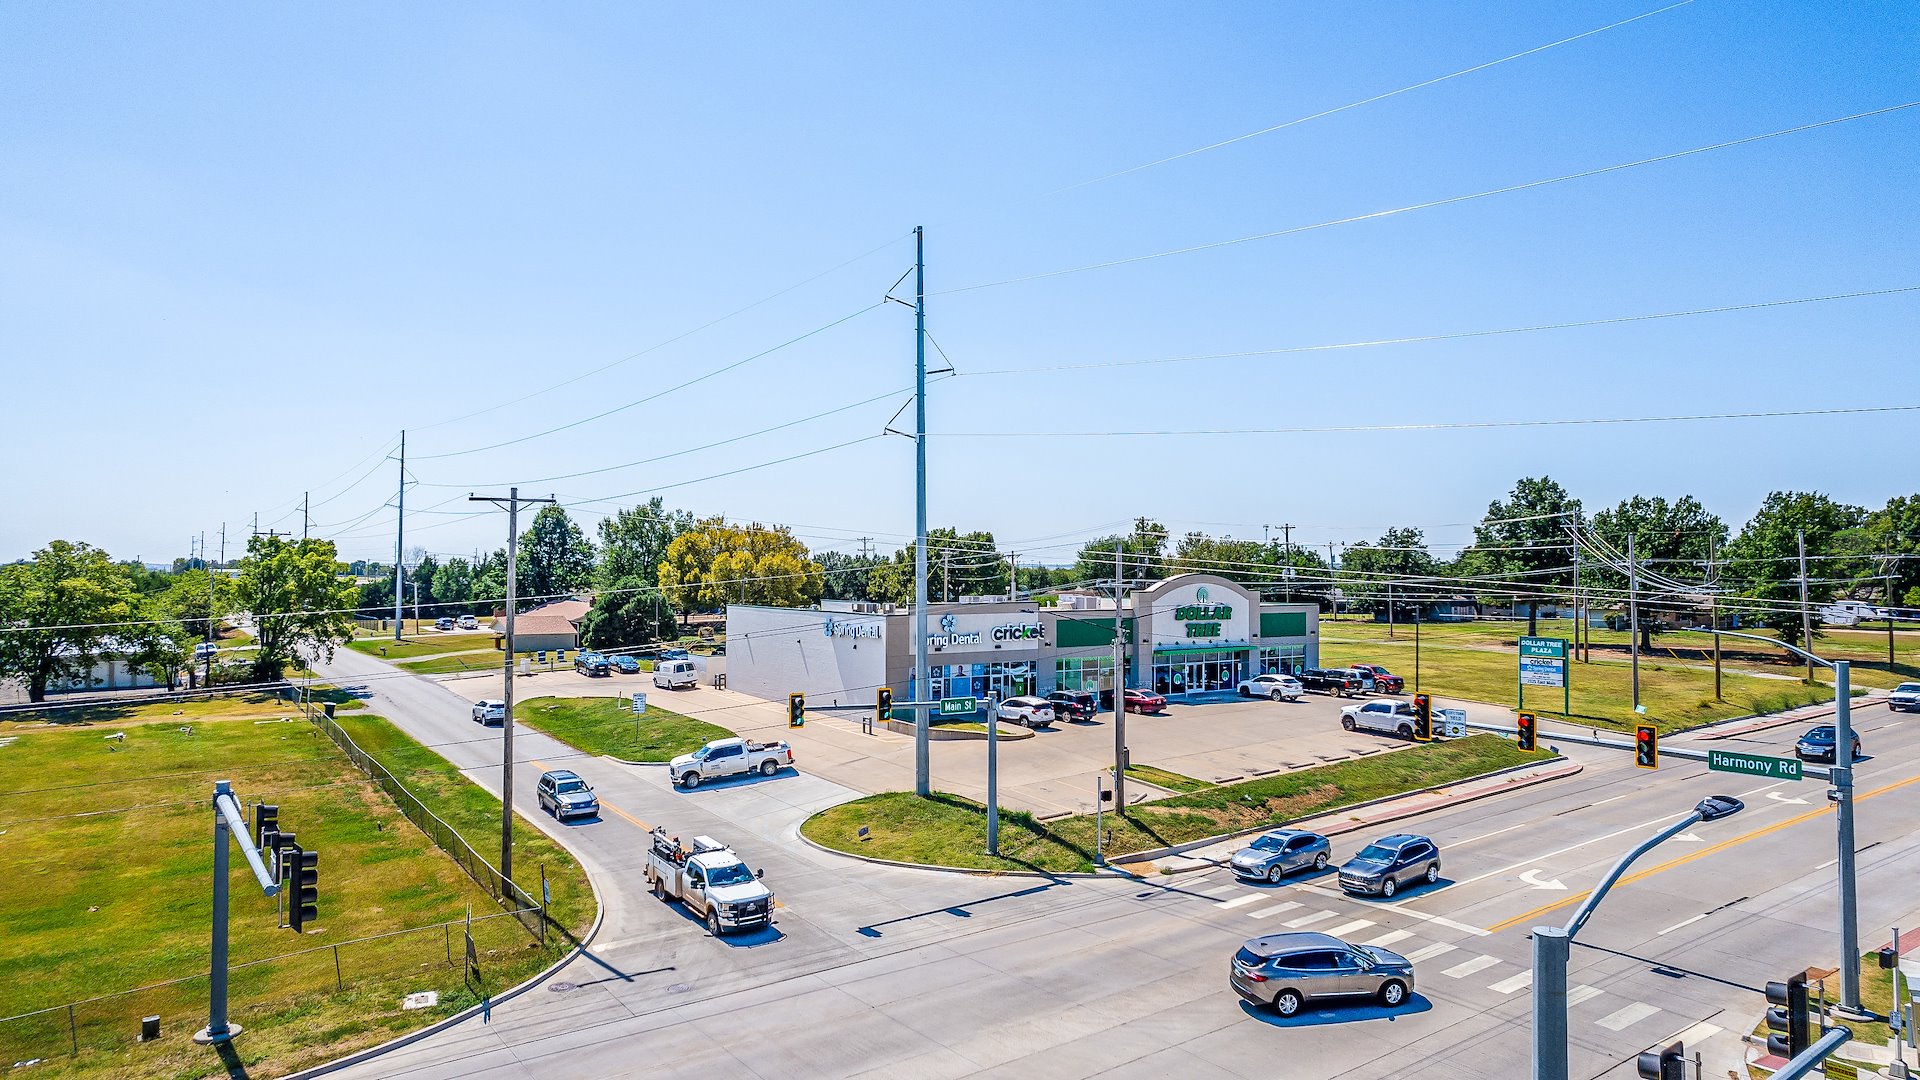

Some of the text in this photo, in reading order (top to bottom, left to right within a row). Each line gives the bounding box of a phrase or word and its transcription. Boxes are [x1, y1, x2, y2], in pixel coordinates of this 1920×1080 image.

[1175, 606, 1232, 620] DOLLAR
[834, 623, 881, 639] Spring Dental
[992, 622, 1045, 641] cricket
[1185, 623, 1221, 638] TREE
[951, 632, 982, 645] Dental
[1530, 658, 1553, 666] cricket
[944, 700, 973, 711] Main St
[1713, 753, 1797, 774] Harmony Rd
